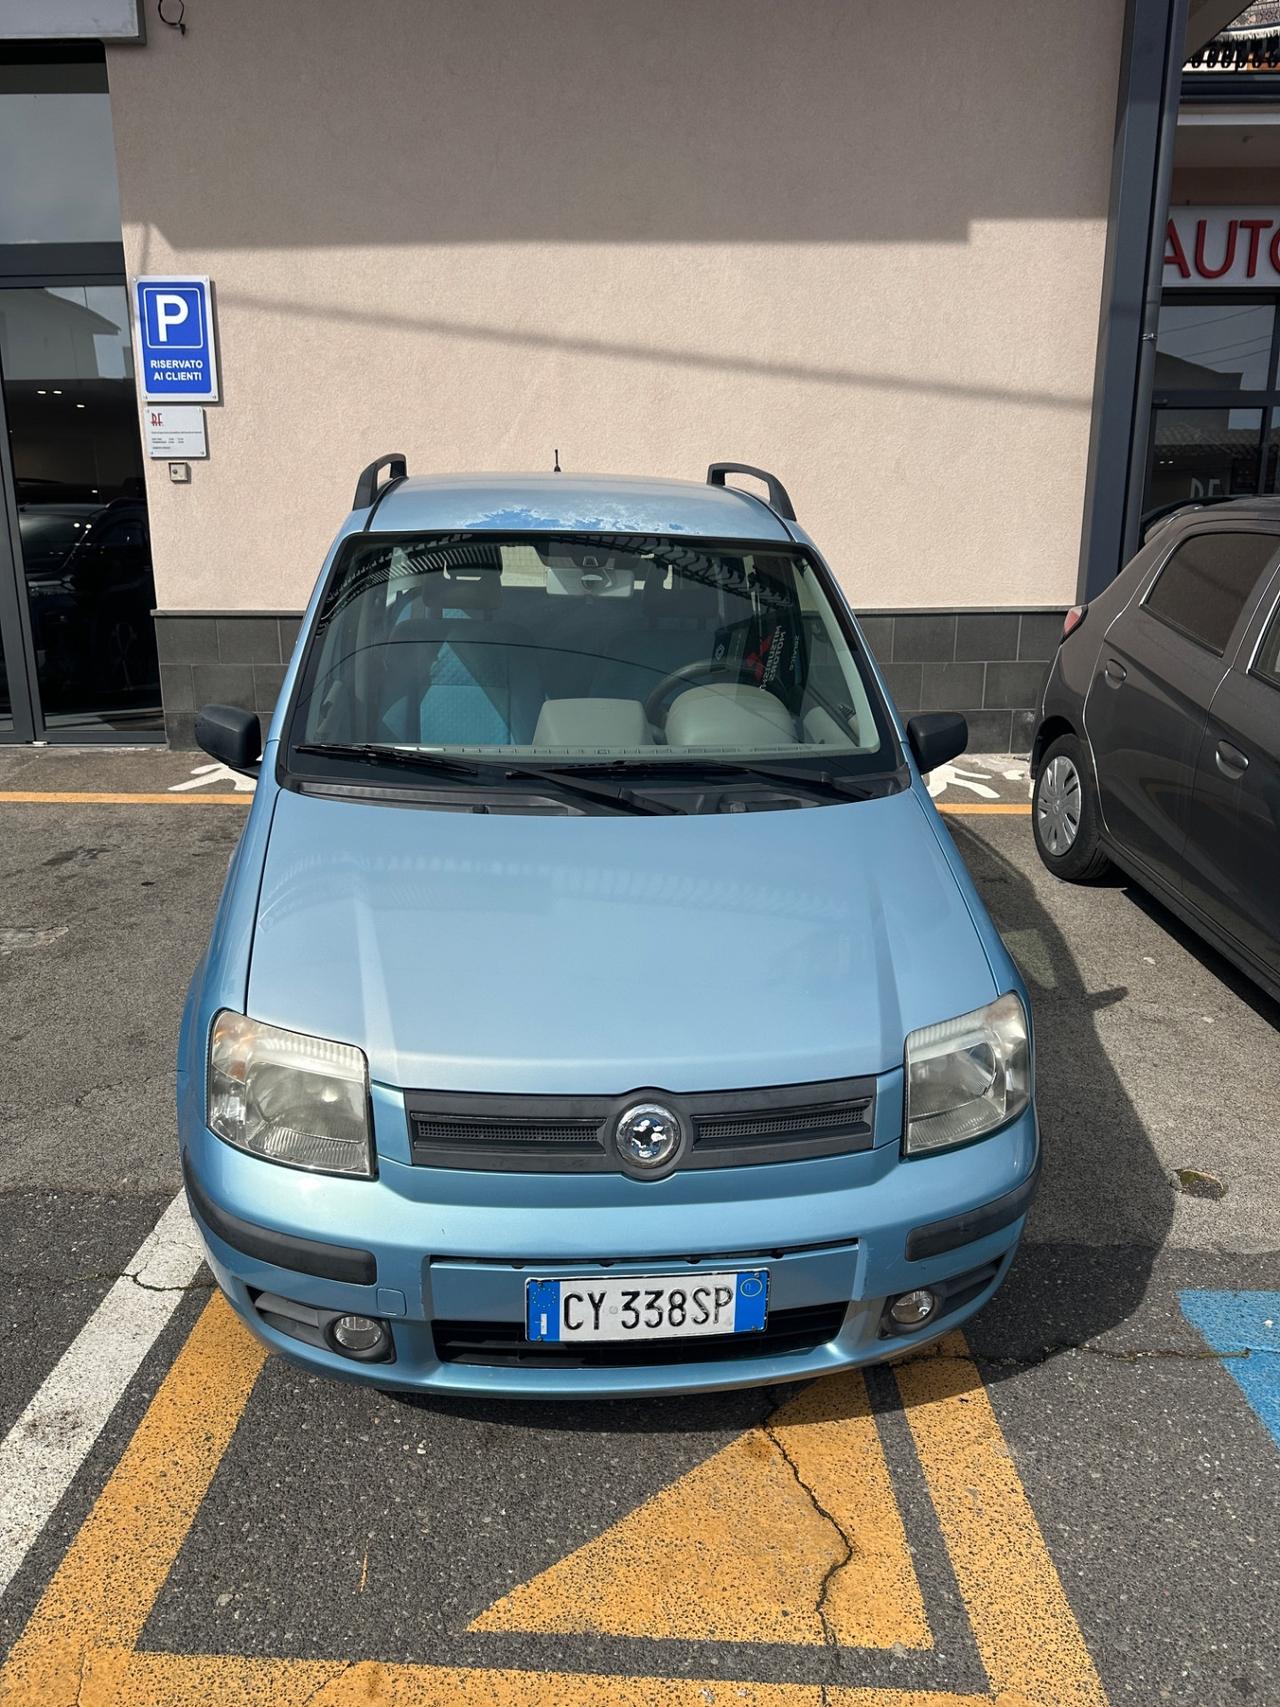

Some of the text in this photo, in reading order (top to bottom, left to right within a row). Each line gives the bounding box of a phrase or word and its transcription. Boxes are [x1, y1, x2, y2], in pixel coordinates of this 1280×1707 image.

[1162, 218, 1280, 279] AUT
[155, 294, 188, 342] P
[150, 360, 203, 369] RISERVATO
[153, 371, 202, 380] AI CLIENTI
[563, 1286, 734, 1331] CY 338SP
